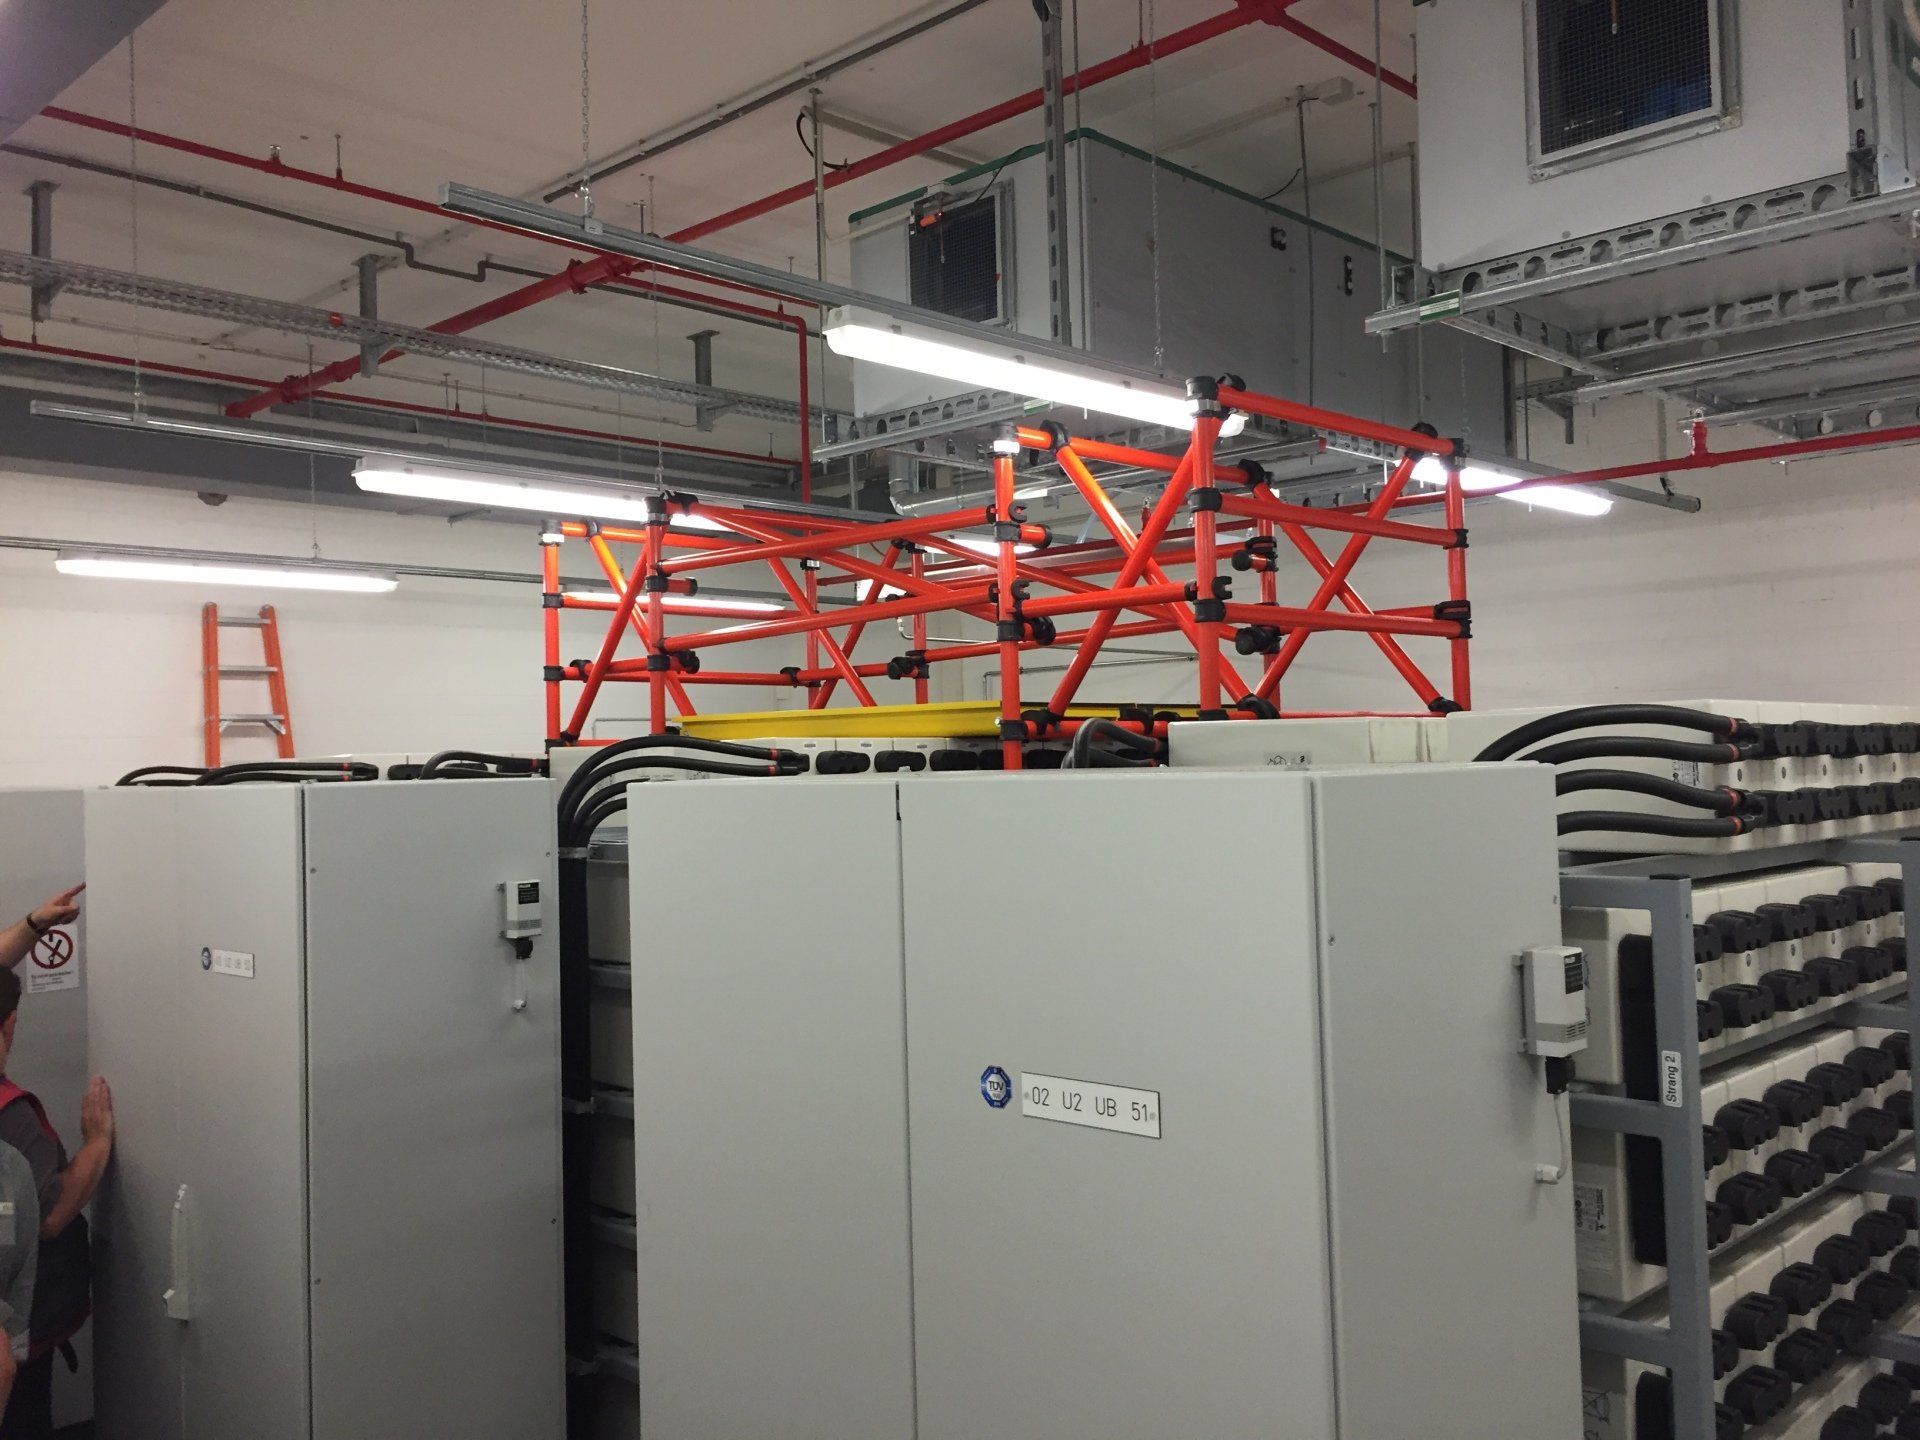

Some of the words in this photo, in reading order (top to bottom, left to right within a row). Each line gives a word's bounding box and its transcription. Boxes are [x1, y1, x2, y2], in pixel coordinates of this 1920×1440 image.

[1664, 1055, 1675, 1063] 2
[1666, 1066, 1679, 1103] Strang
[1032, 1086, 1050, 1107] 02
[1062, 1091, 1082, 1112] U2
[1095, 1096, 1117, 1118] UB
[1131, 1101, 1148, 1122] 51
